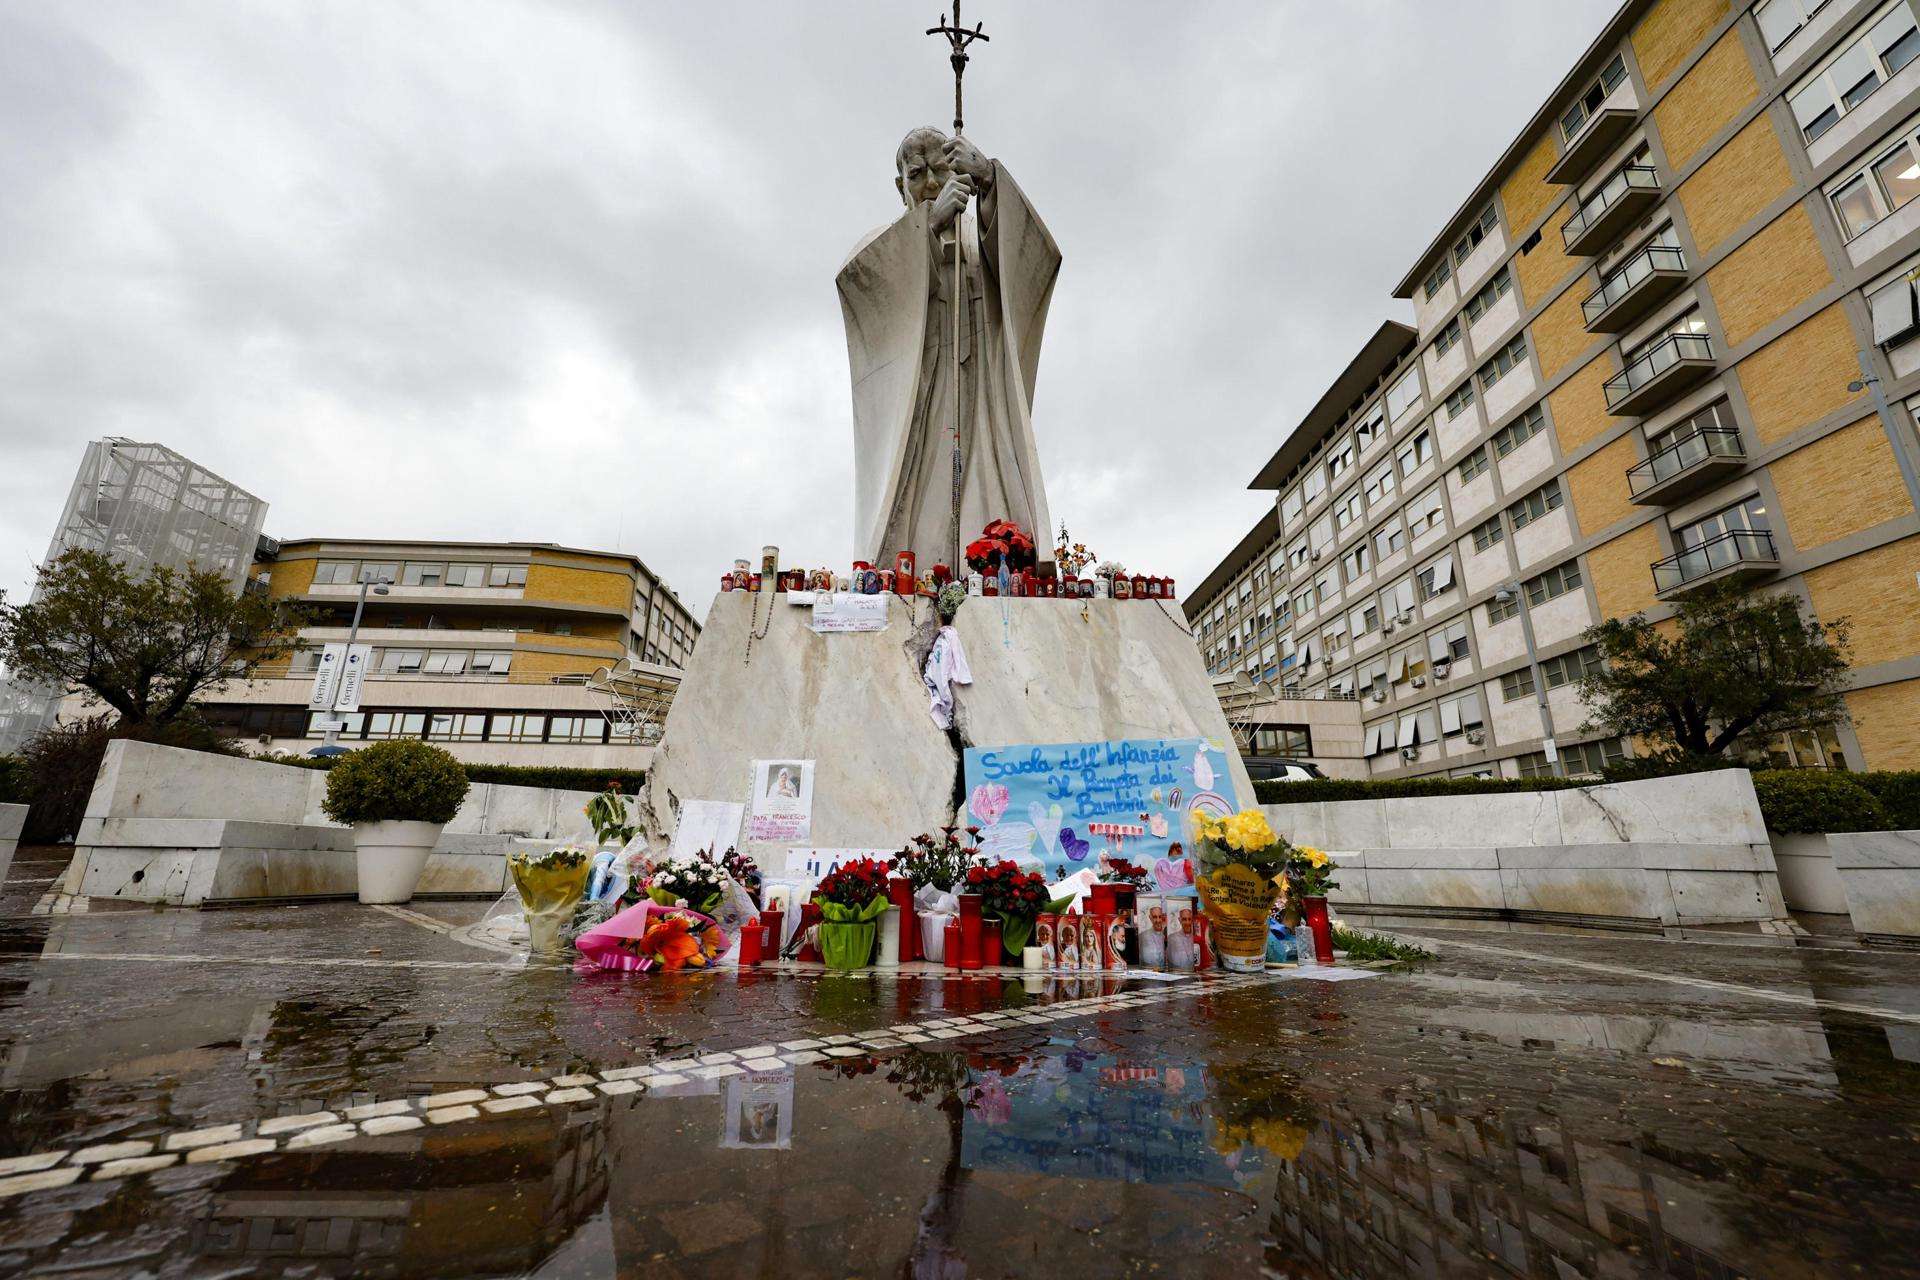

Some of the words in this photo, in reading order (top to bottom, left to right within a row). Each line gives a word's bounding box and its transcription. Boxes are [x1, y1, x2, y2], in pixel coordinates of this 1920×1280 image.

[313, 668, 330, 704] Gemelli
[340, 670, 356, 705] Gemelli
[1149, 764, 1178, 785] dei
[1072, 789, 1147, 819] Bambini
